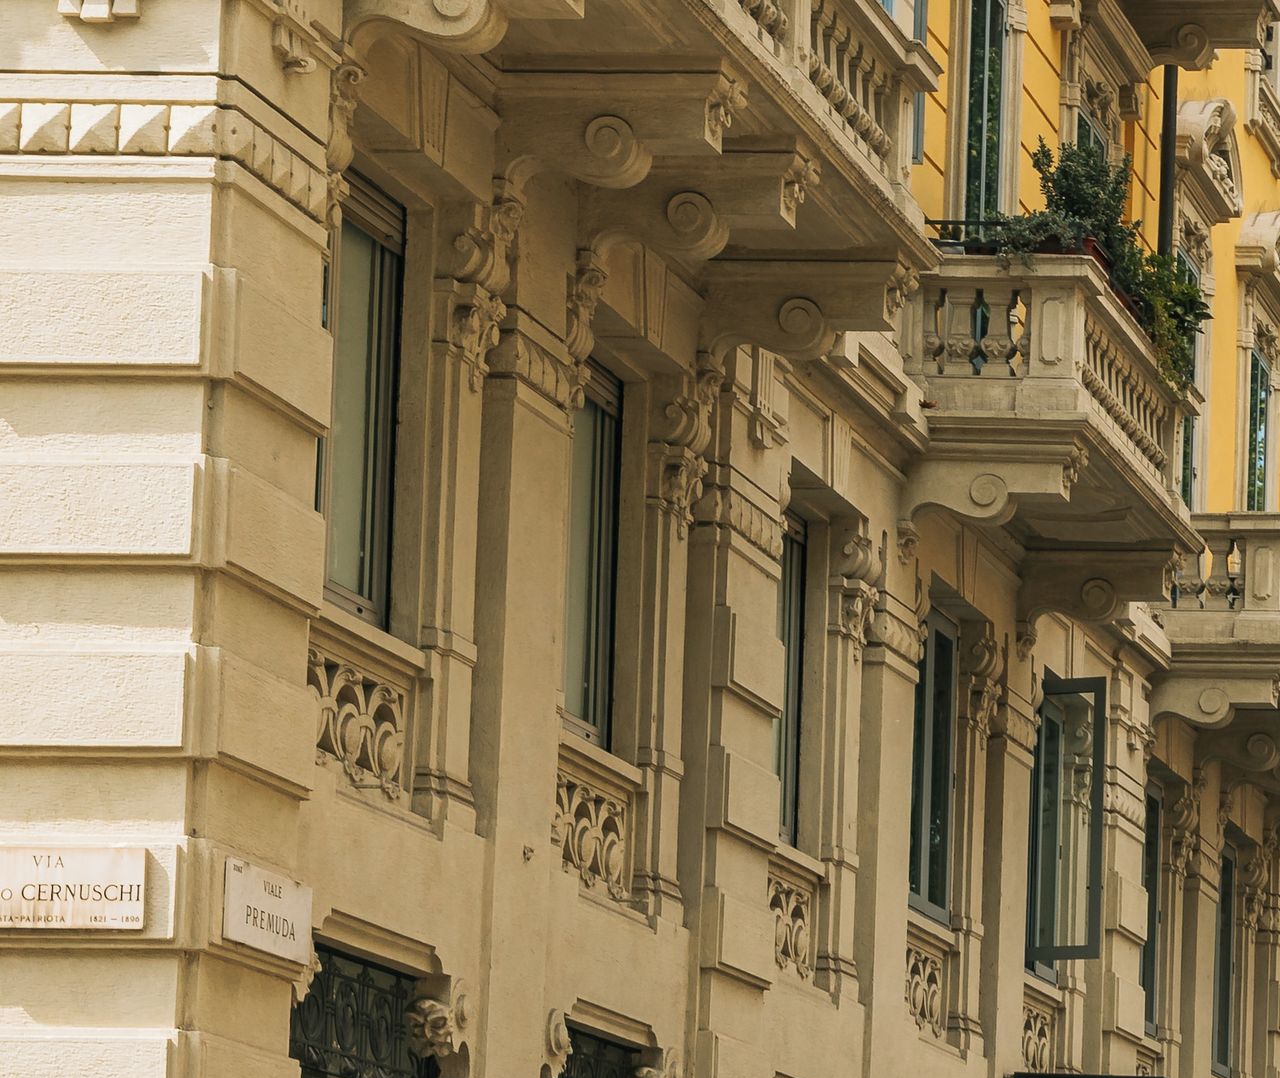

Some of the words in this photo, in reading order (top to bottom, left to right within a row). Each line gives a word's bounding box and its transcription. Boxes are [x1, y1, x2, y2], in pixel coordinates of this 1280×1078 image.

[33, 855, 65, 868] VIA
[21, 884, 142, 901] CERNUSCHI
[263, 880, 282, 899] VIALE
[245, 905, 296, 941] PREMUDA
